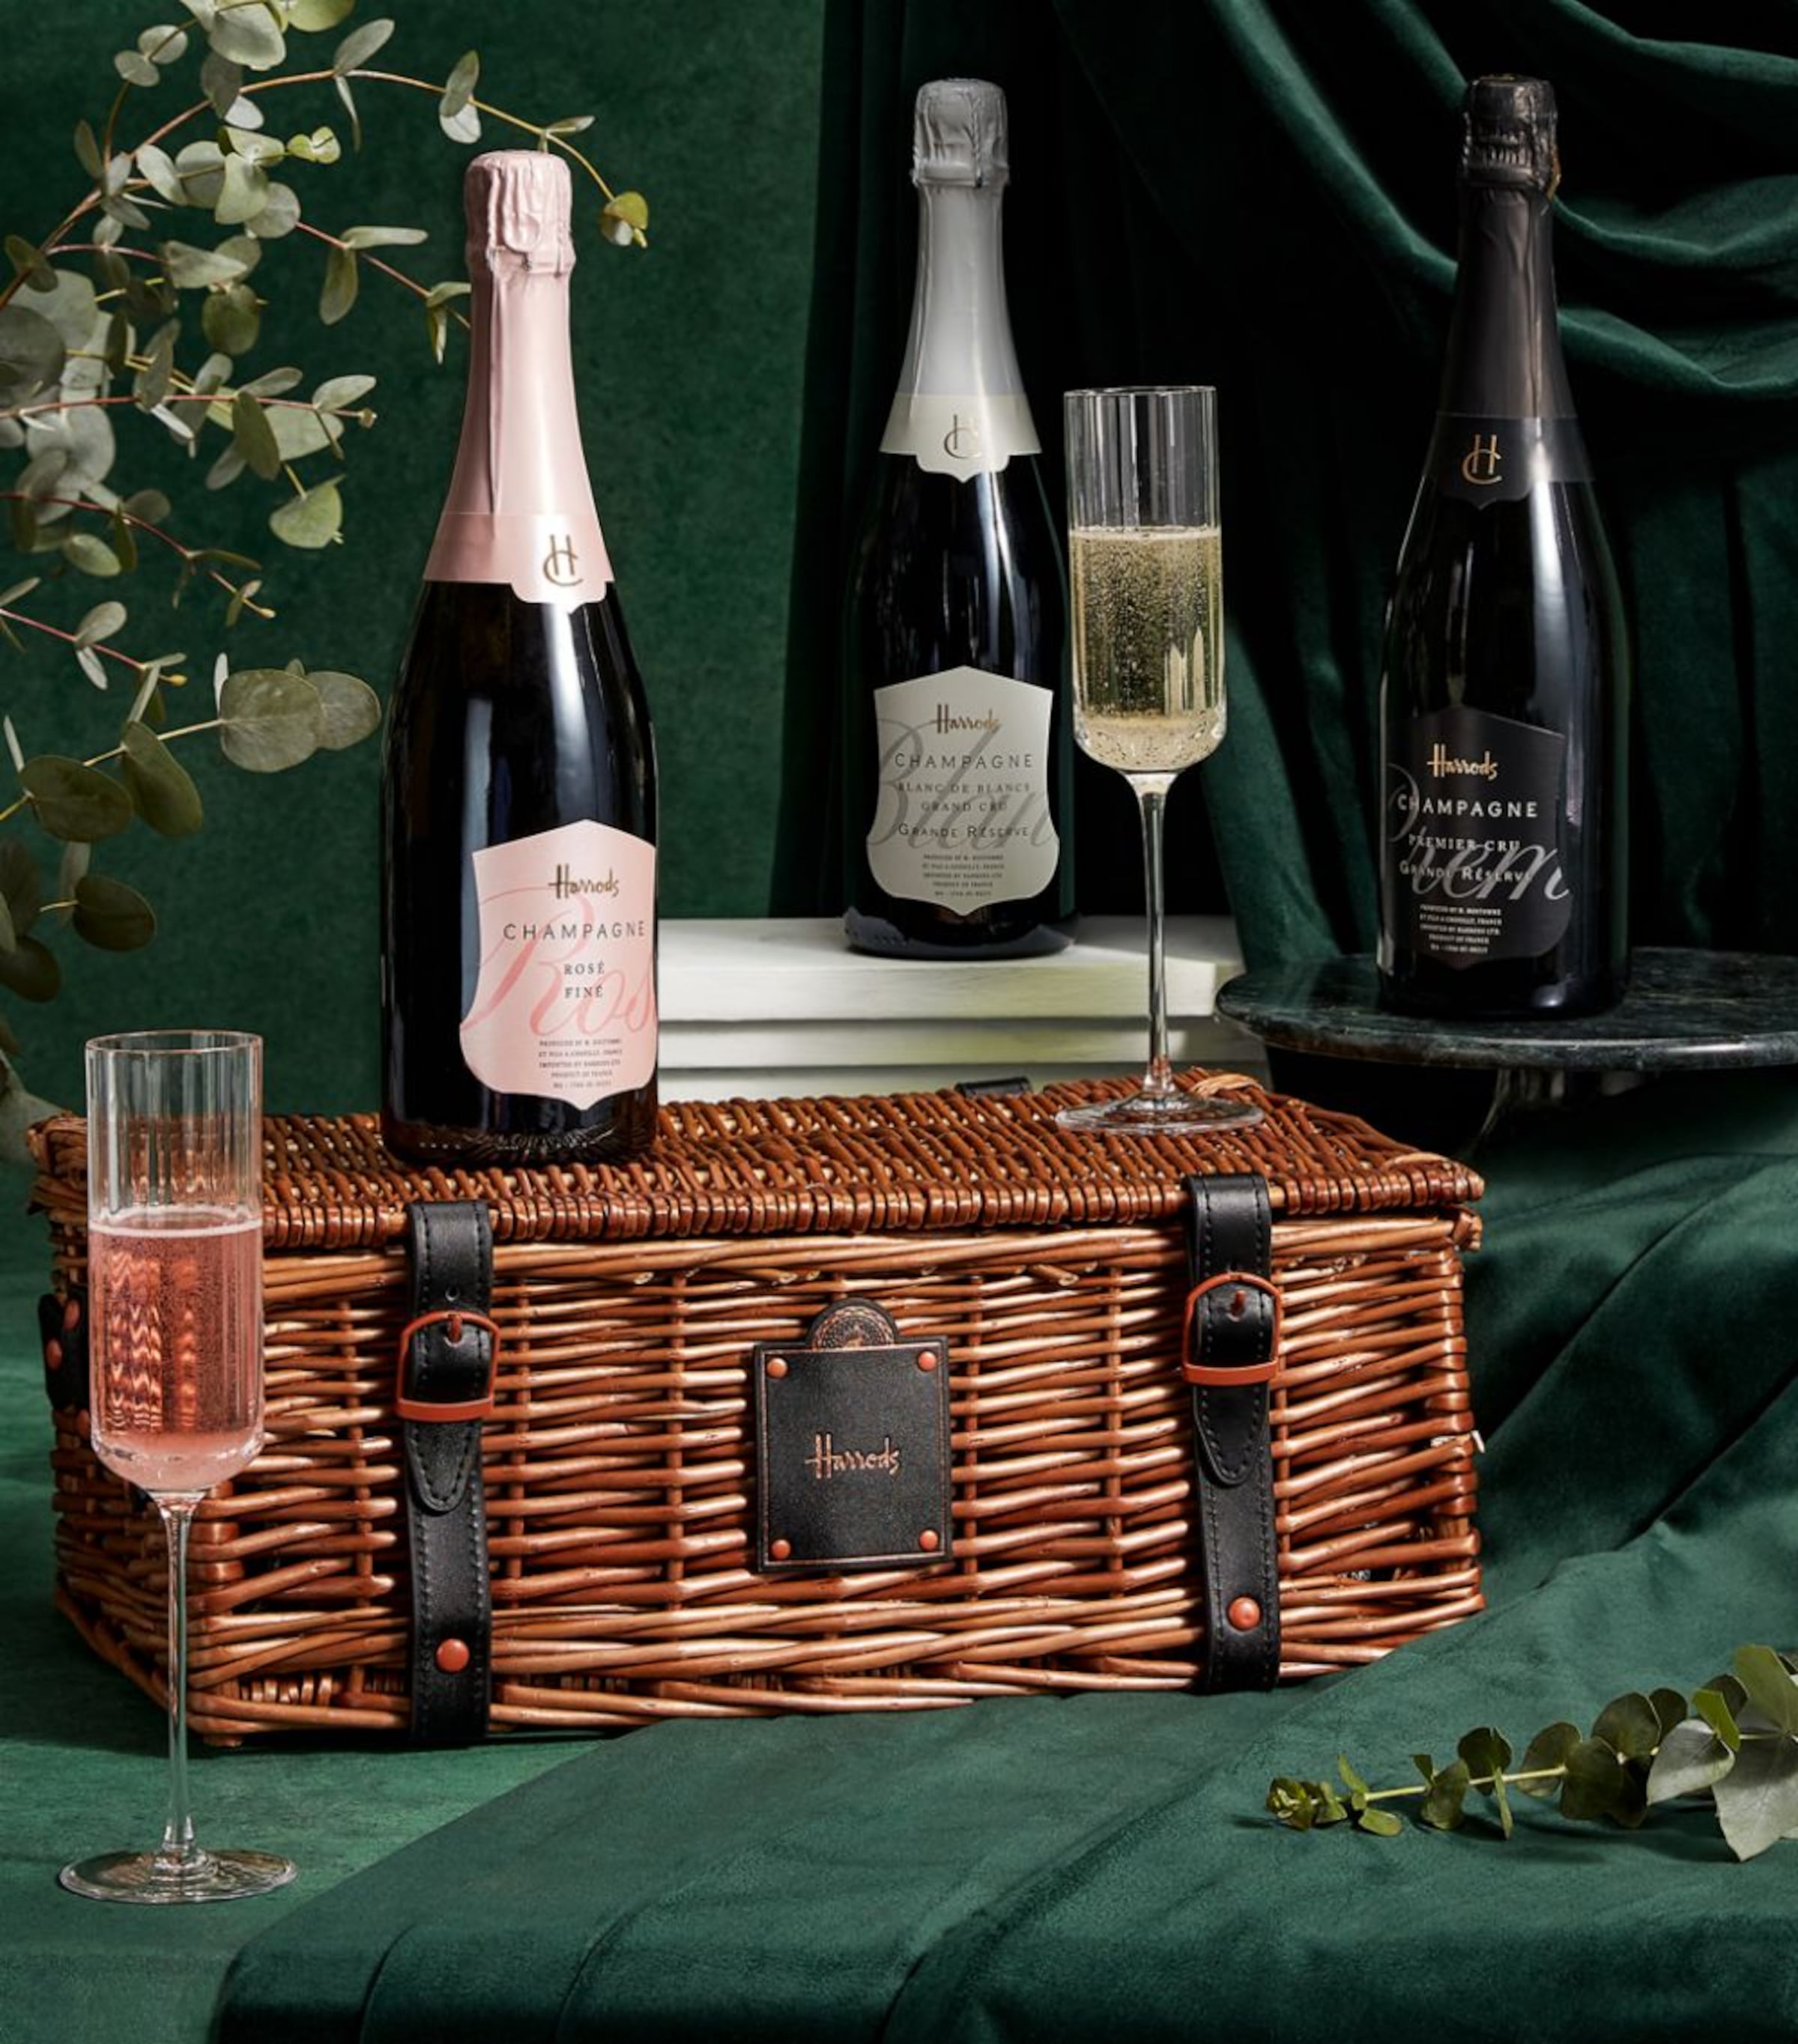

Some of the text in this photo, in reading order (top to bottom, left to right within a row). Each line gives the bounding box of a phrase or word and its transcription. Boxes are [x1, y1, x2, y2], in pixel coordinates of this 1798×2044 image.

[895, 752, 1034, 769] CHAMPAGNE
[1426, 743, 1498, 780] Harrods
[950, 783, 969, 794] DE
[921, 800, 972, 812] GRAND
[1398, 794, 1538, 818] CHAMPAGNE
[1484, 840, 1521, 852] CRU
[548, 863, 620, 900] Harrods
[503, 920, 646, 941] CHAMPAGNE
[563, 958, 605, 975] ROSÉ
[805, 1432, 900, 1479] Harrods
